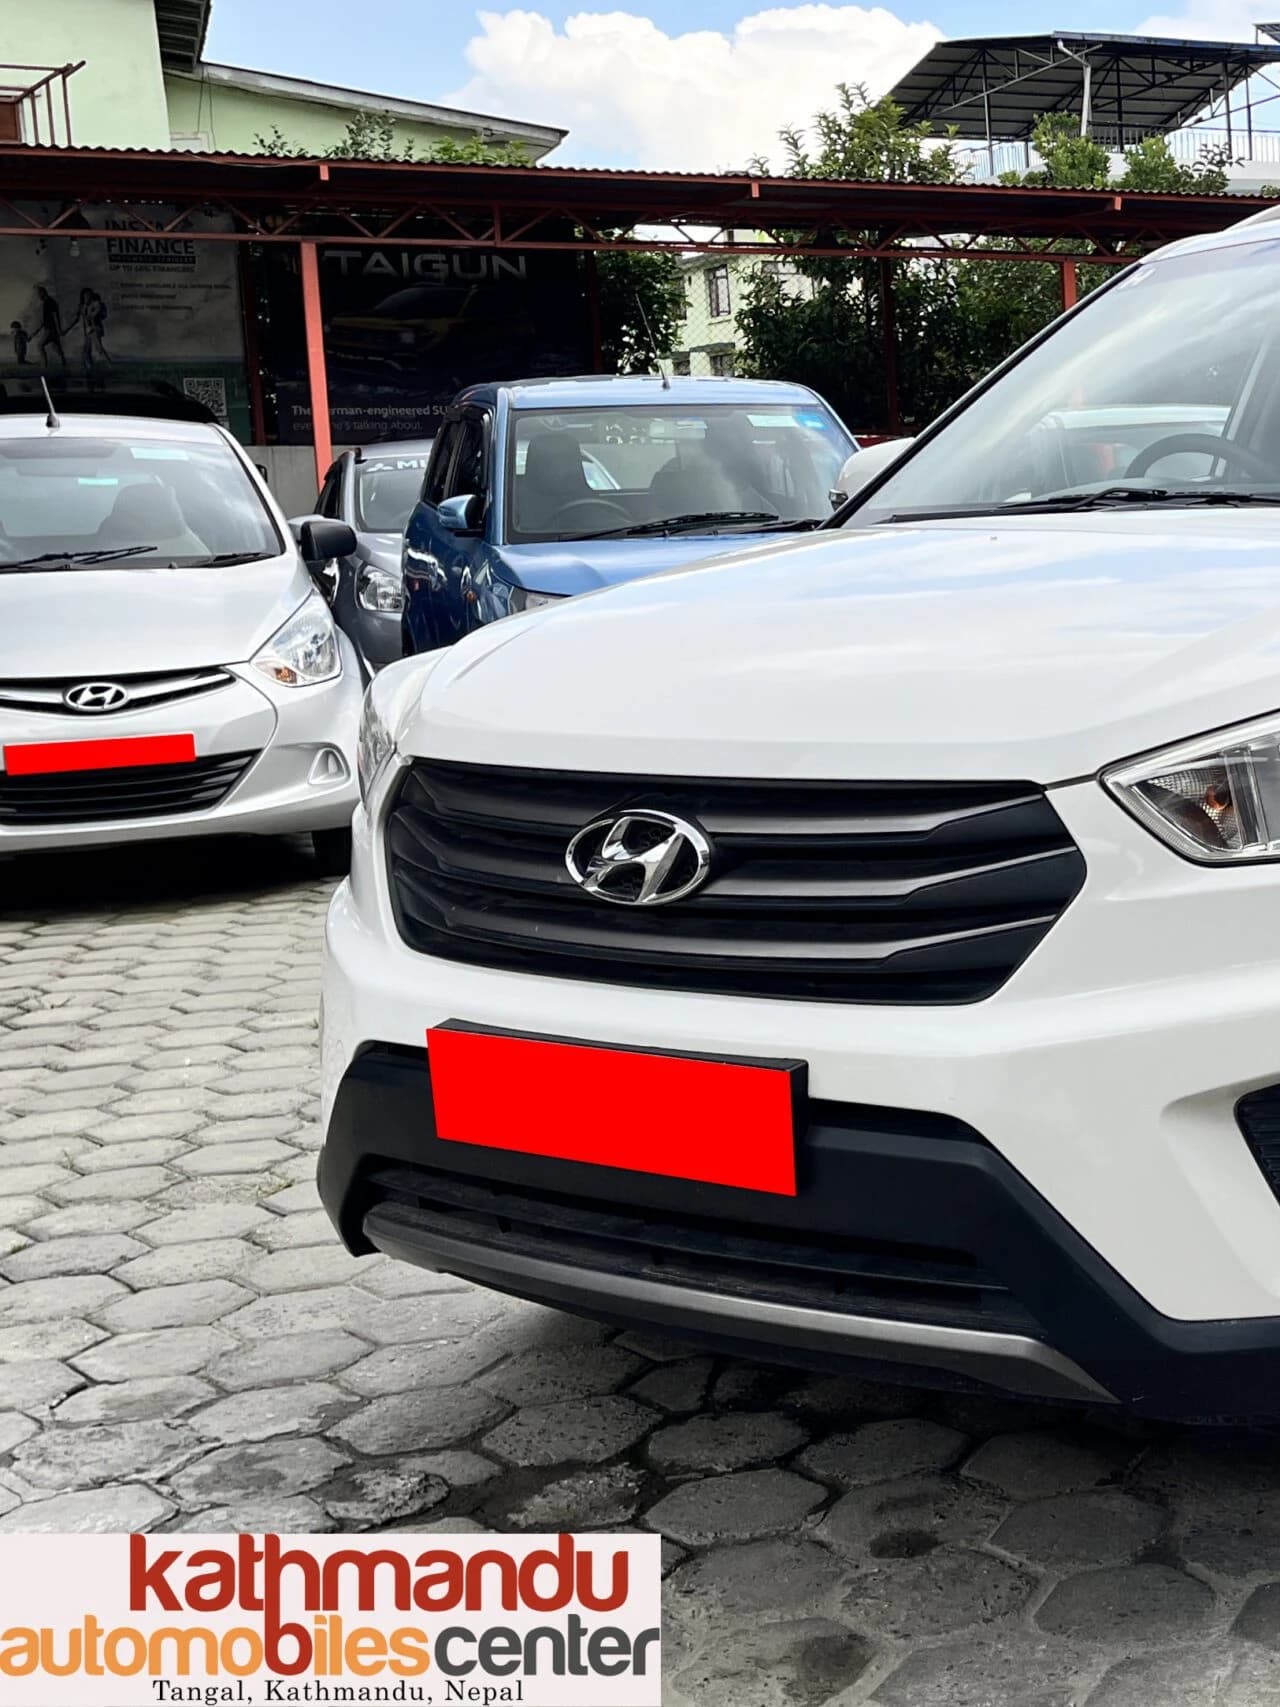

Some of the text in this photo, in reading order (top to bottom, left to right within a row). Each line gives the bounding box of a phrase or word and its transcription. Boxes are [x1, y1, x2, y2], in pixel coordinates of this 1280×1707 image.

[107, 239, 195, 254] FINANCE
[323, 249, 528, 281] TAIGUN
[432, 405, 449, 416] SU
